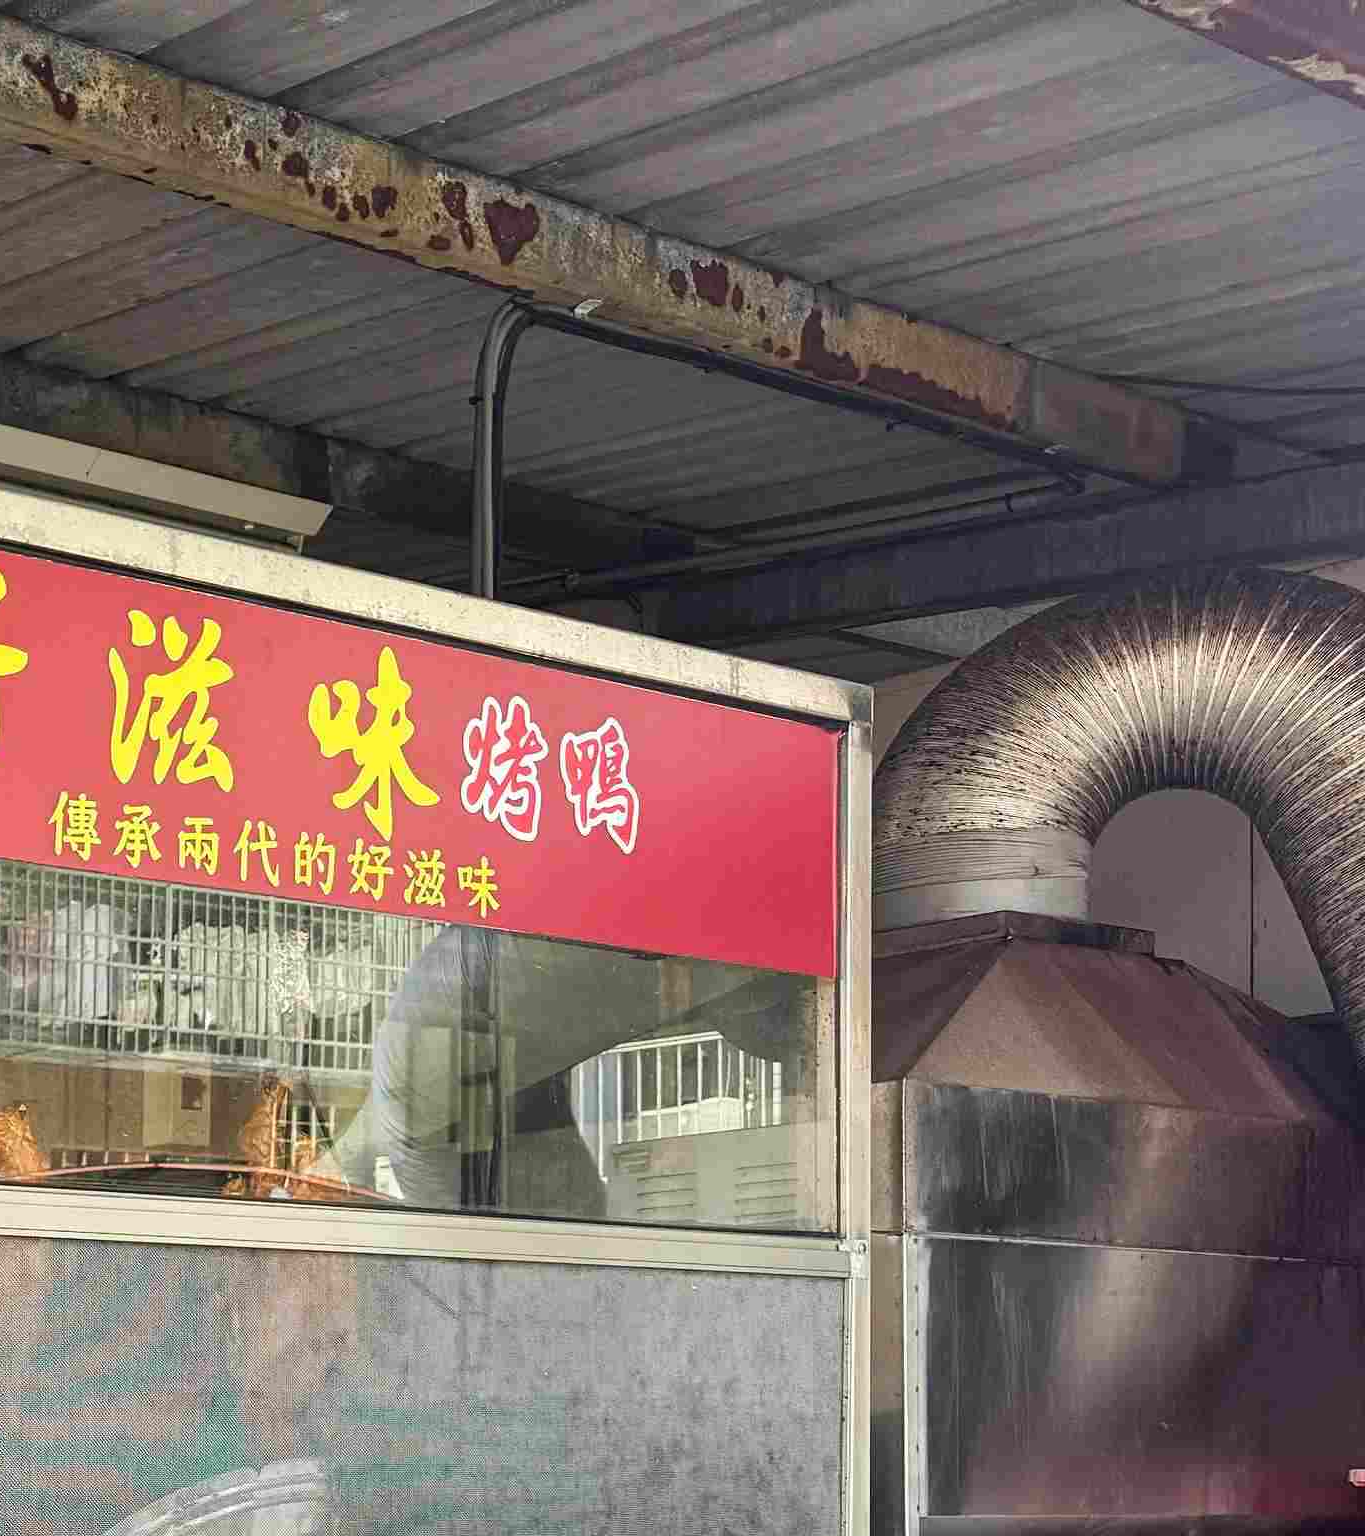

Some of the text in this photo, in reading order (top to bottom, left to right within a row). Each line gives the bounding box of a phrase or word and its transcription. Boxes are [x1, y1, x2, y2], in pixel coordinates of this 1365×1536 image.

[50, 790, 501, 919] 傳承兩代的好滋味
